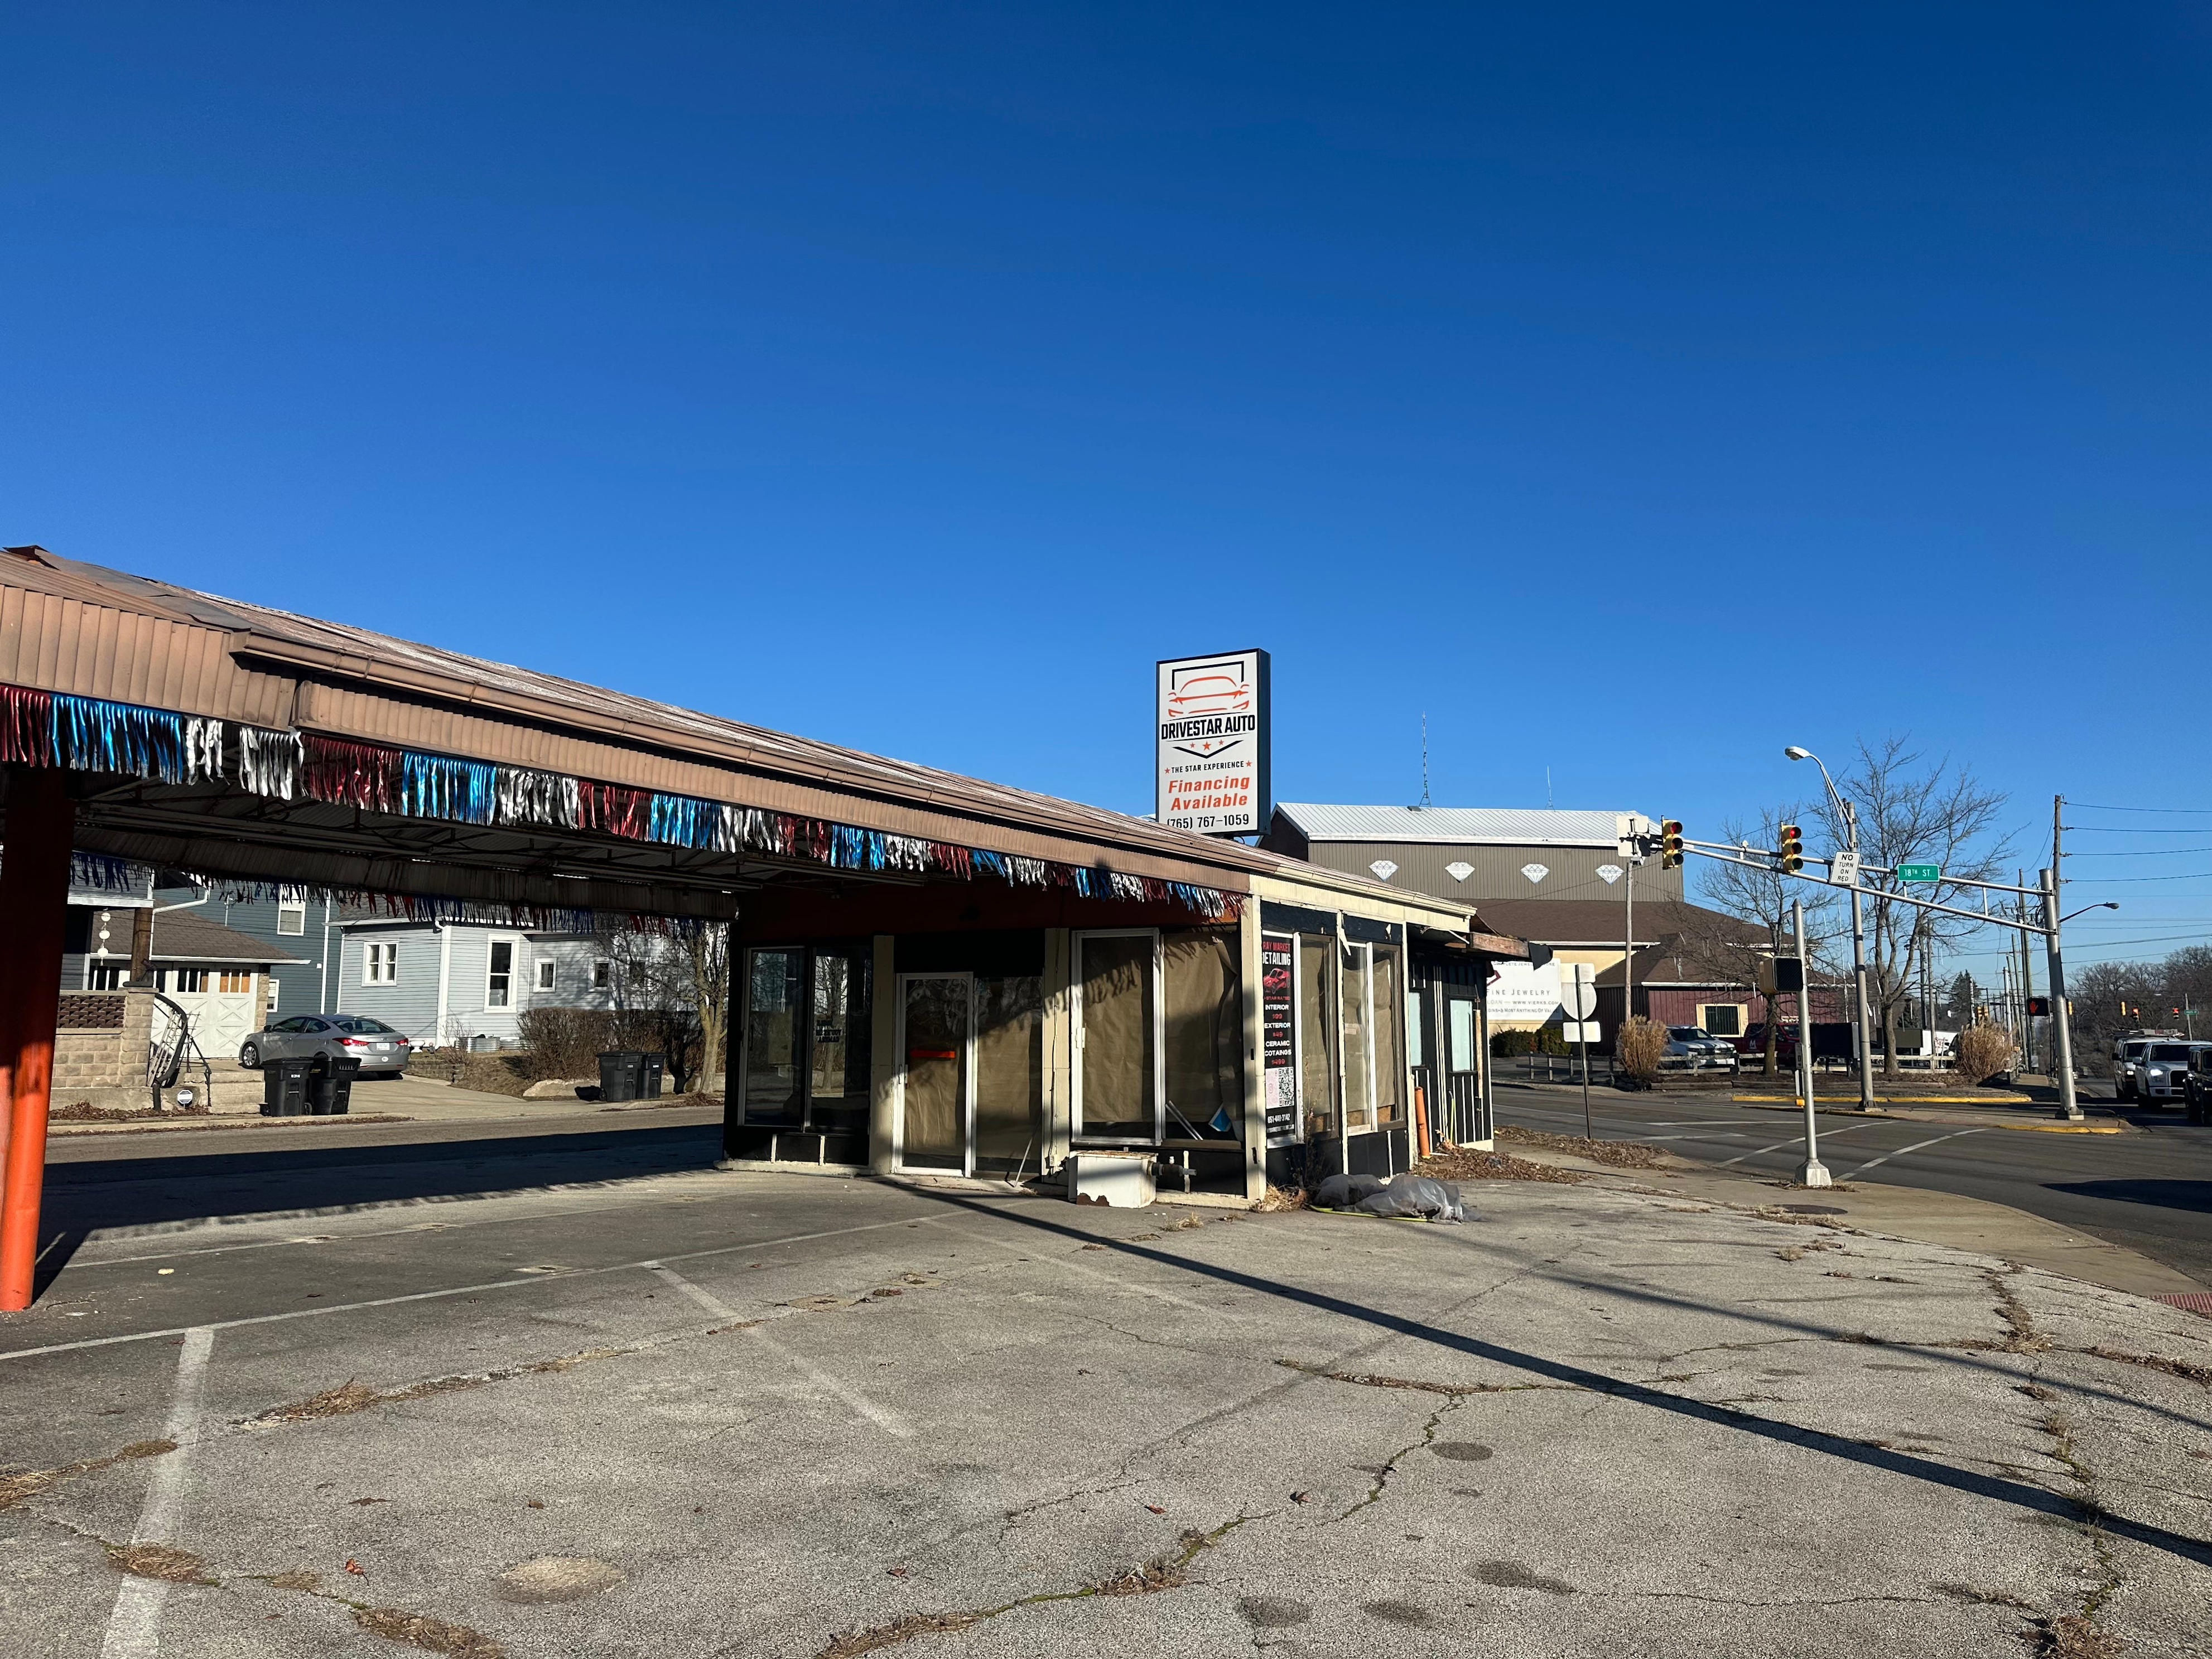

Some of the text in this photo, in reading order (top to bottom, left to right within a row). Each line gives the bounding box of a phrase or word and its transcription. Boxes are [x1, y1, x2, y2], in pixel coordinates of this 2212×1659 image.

[1161, 715, 1255, 740] DRIVESTAR AUTO
[1204, 761, 1244, 770] EXPERIENCE
[1168, 776, 1250, 793] Financing
[1170, 793, 1247, 811] Available
[1167, 814, 1249, 830] (765) 767-1059
[1904, 869, 1918, 877] 18TH
[1262, 941, 1290, 952] RAY MARKET
